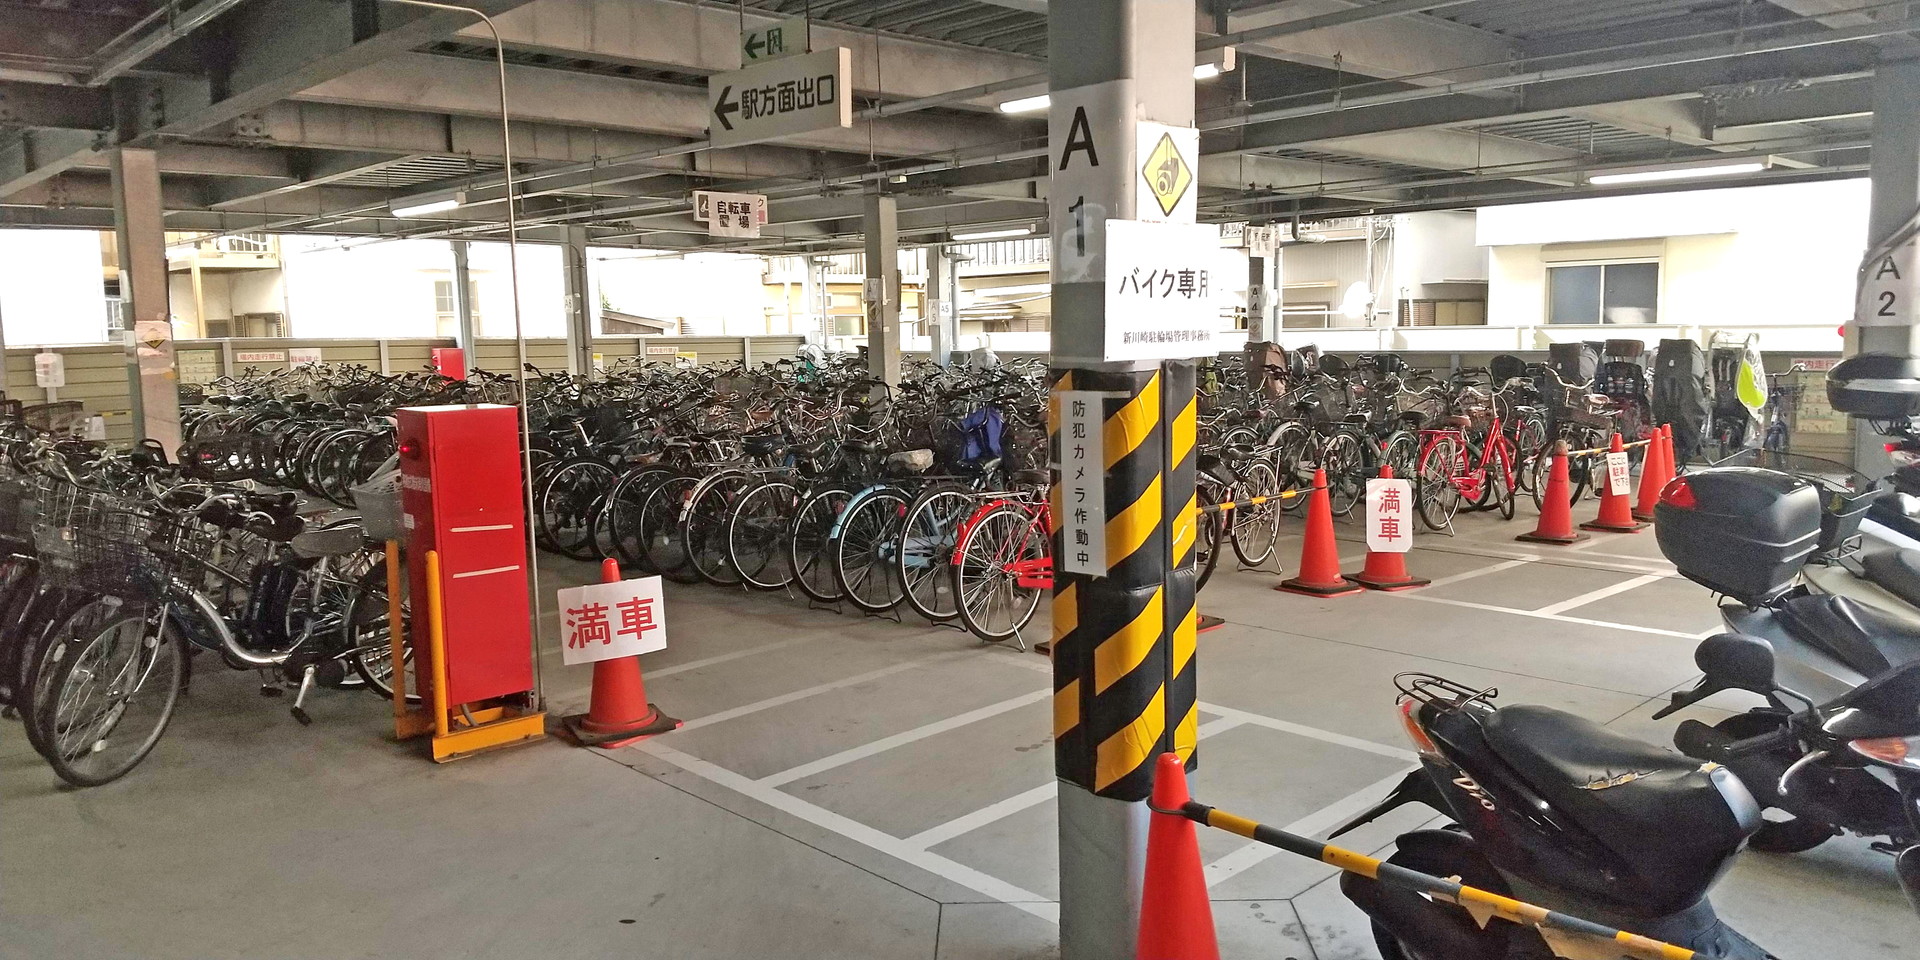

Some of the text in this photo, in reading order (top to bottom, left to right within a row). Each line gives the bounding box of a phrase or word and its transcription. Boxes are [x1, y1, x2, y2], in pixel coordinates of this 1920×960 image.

[742, 74, 834, 119] 駅方面出口
[717, 201, 751, 215] 自転車
[1072, 400, 1090, 567] 防犯カメラ作動中
[1378, 488, 1402, 542] 満車
[566, 596, 658, 649] 満車
